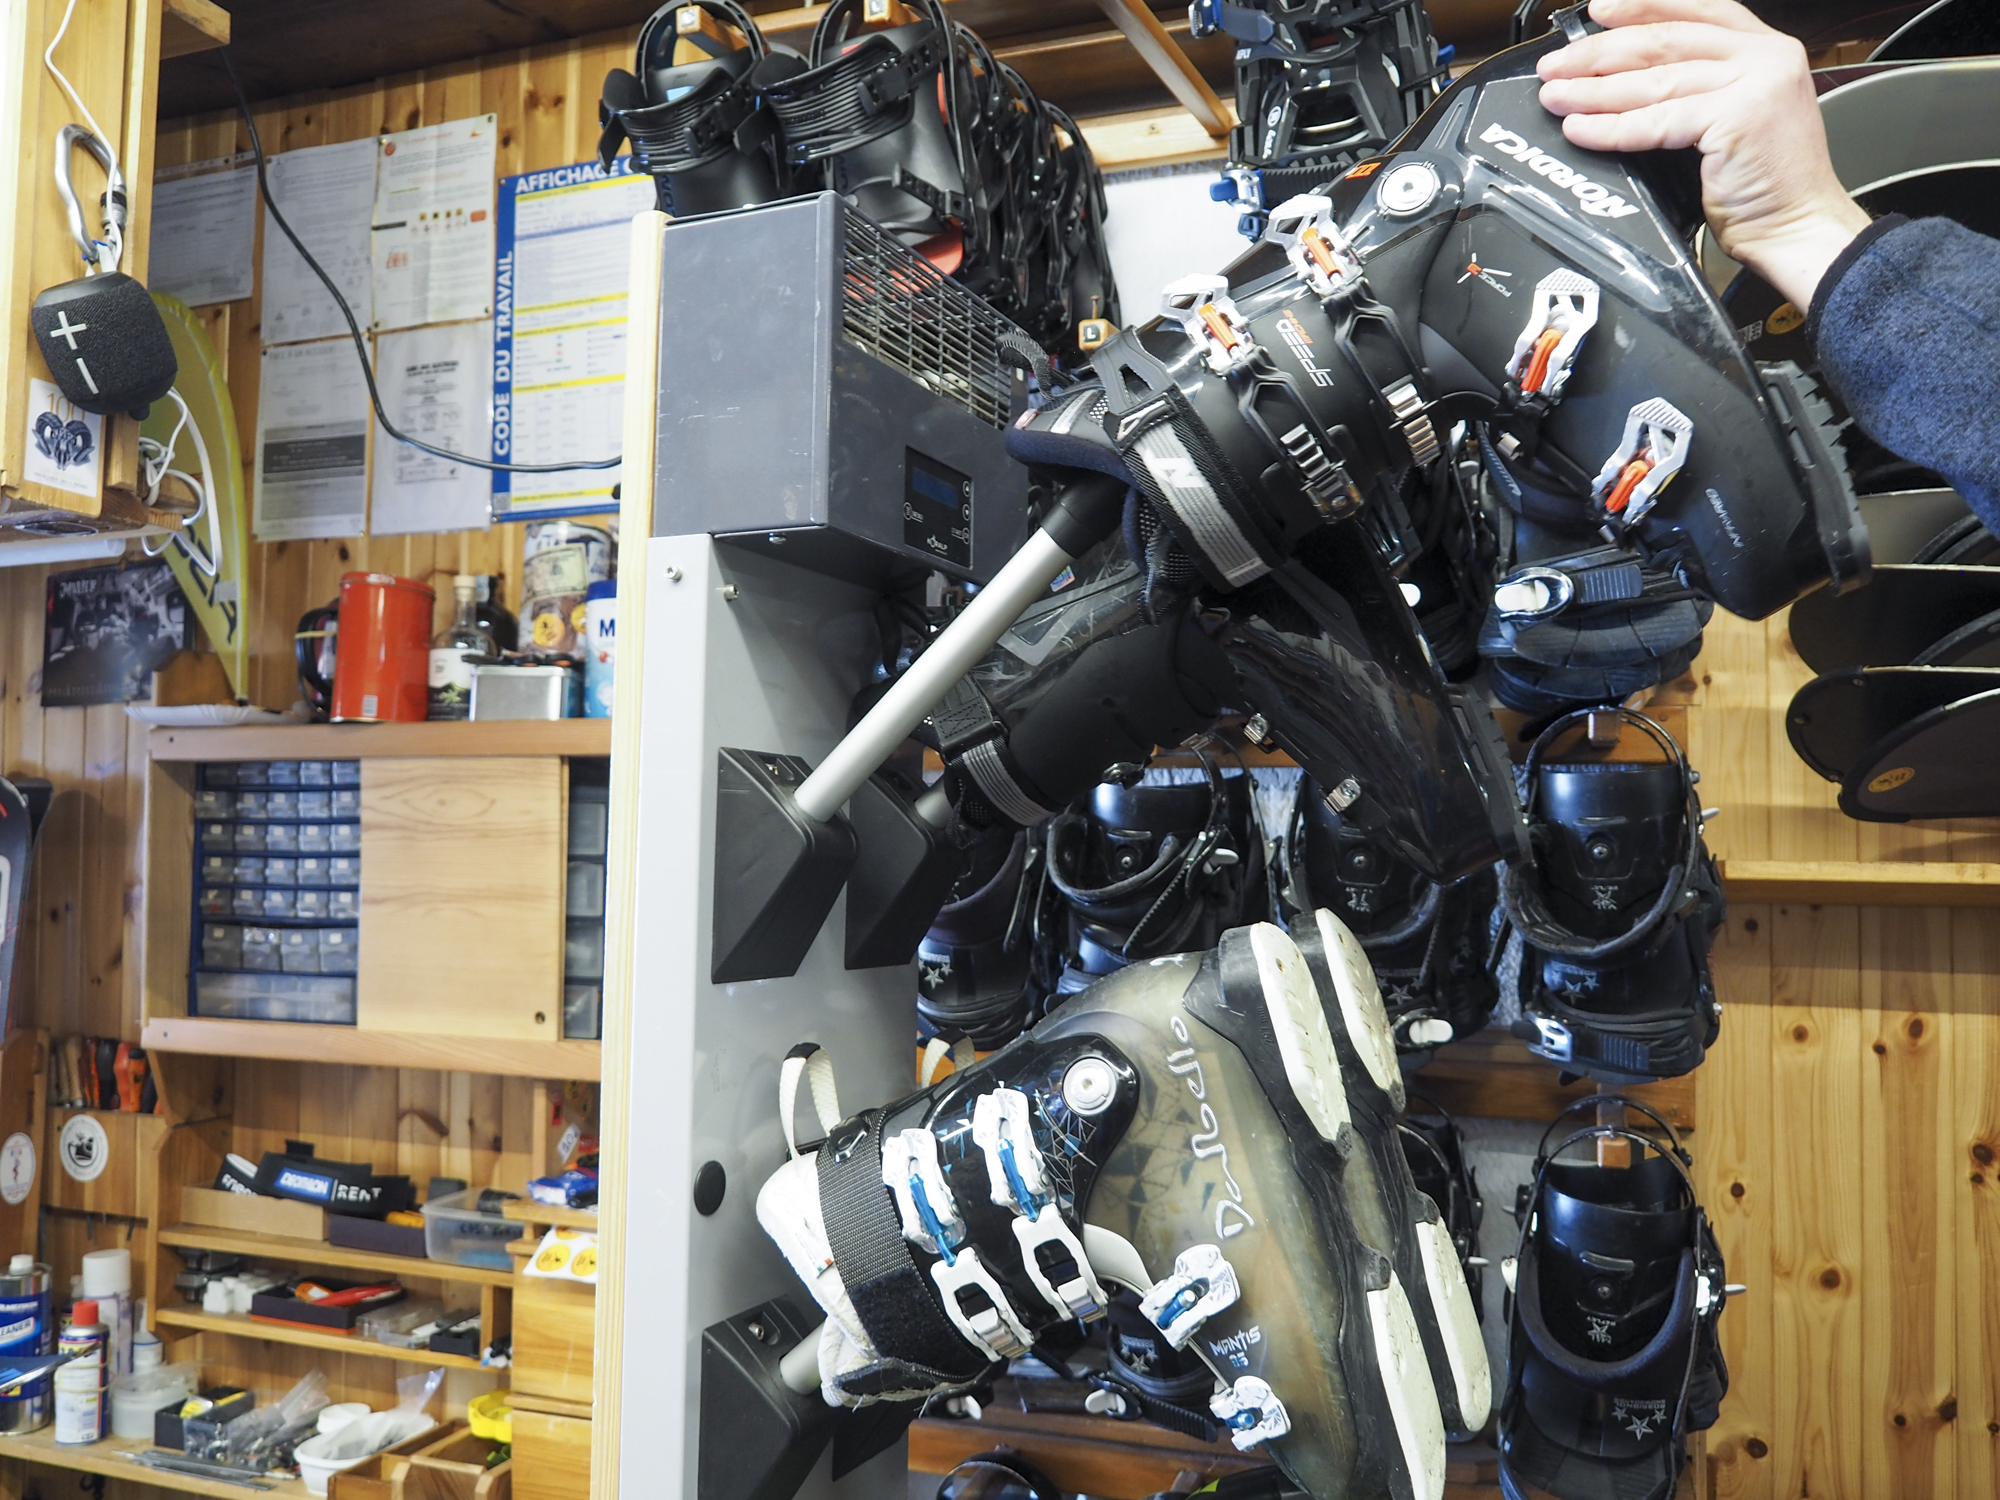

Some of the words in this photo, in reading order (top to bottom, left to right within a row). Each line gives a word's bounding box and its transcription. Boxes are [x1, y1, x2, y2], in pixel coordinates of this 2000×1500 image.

[1479, 122, 1640, 218] NORDICA
[496, 250, 513, 341] TRAVAIL
[1476, 272, 1513, 298] FORCE
[1087, 326, 1096, 339] L
[1276, 318, 1335, 387] SPEED
[496, 349, 511, 382] DU
[494, 392, 510, 455] CODE
[1705, 488, 1745, 548] INFRARED
[1167, 1015, 1255, 1241] Dalbello
[279, 1171, 329, 1195] DECATHLON
[337, 1184, 382, 1202] RENT
[0, 1320, 31, 1336] EANER
[1209, 1325, 1262, 1357] MANTIS
